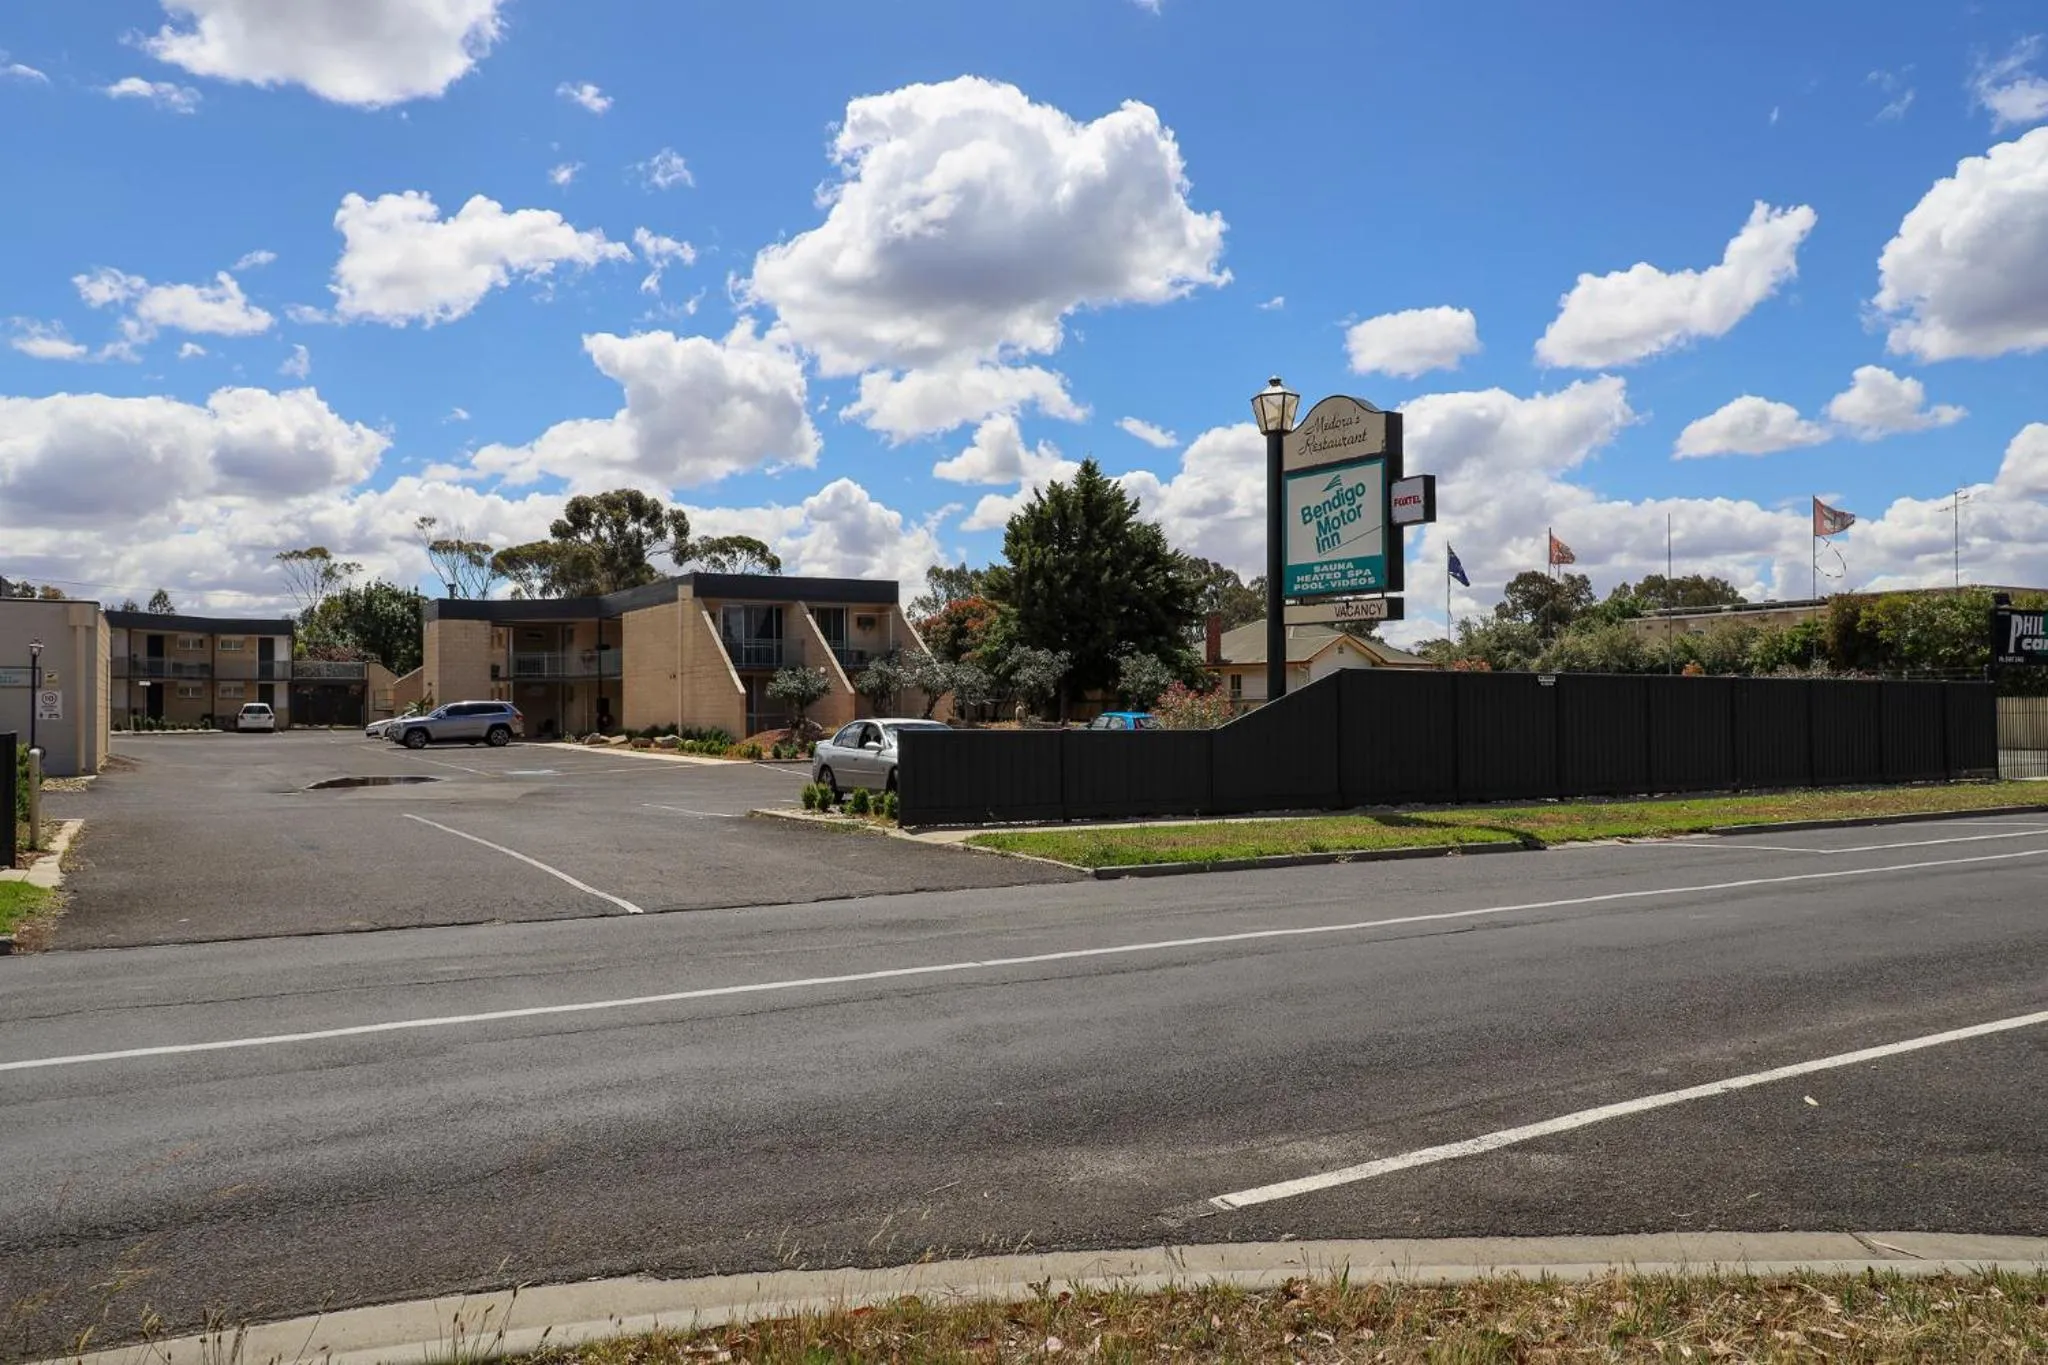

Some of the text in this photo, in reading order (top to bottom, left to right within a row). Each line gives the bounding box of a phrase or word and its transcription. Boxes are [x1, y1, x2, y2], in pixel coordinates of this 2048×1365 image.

[1304, 407, 1361, 434] Medora's
[1298, 428, 1367, 455] Restaurant
[1300, 482, 1366, 525] Bendigo
[1394, 495, 1421, 508] FOXTEL
[1316, 504, 1363, 538] Motor
[1316, 531, 1341, 554] Inn
[1296, 568, 1372, 583] HEATED SPA
[1313, 562, 1354, 573] SAUNA
[1334, 602, 1383, 618] VACANCY
[2008, 614, 2046, 654] PHIL
